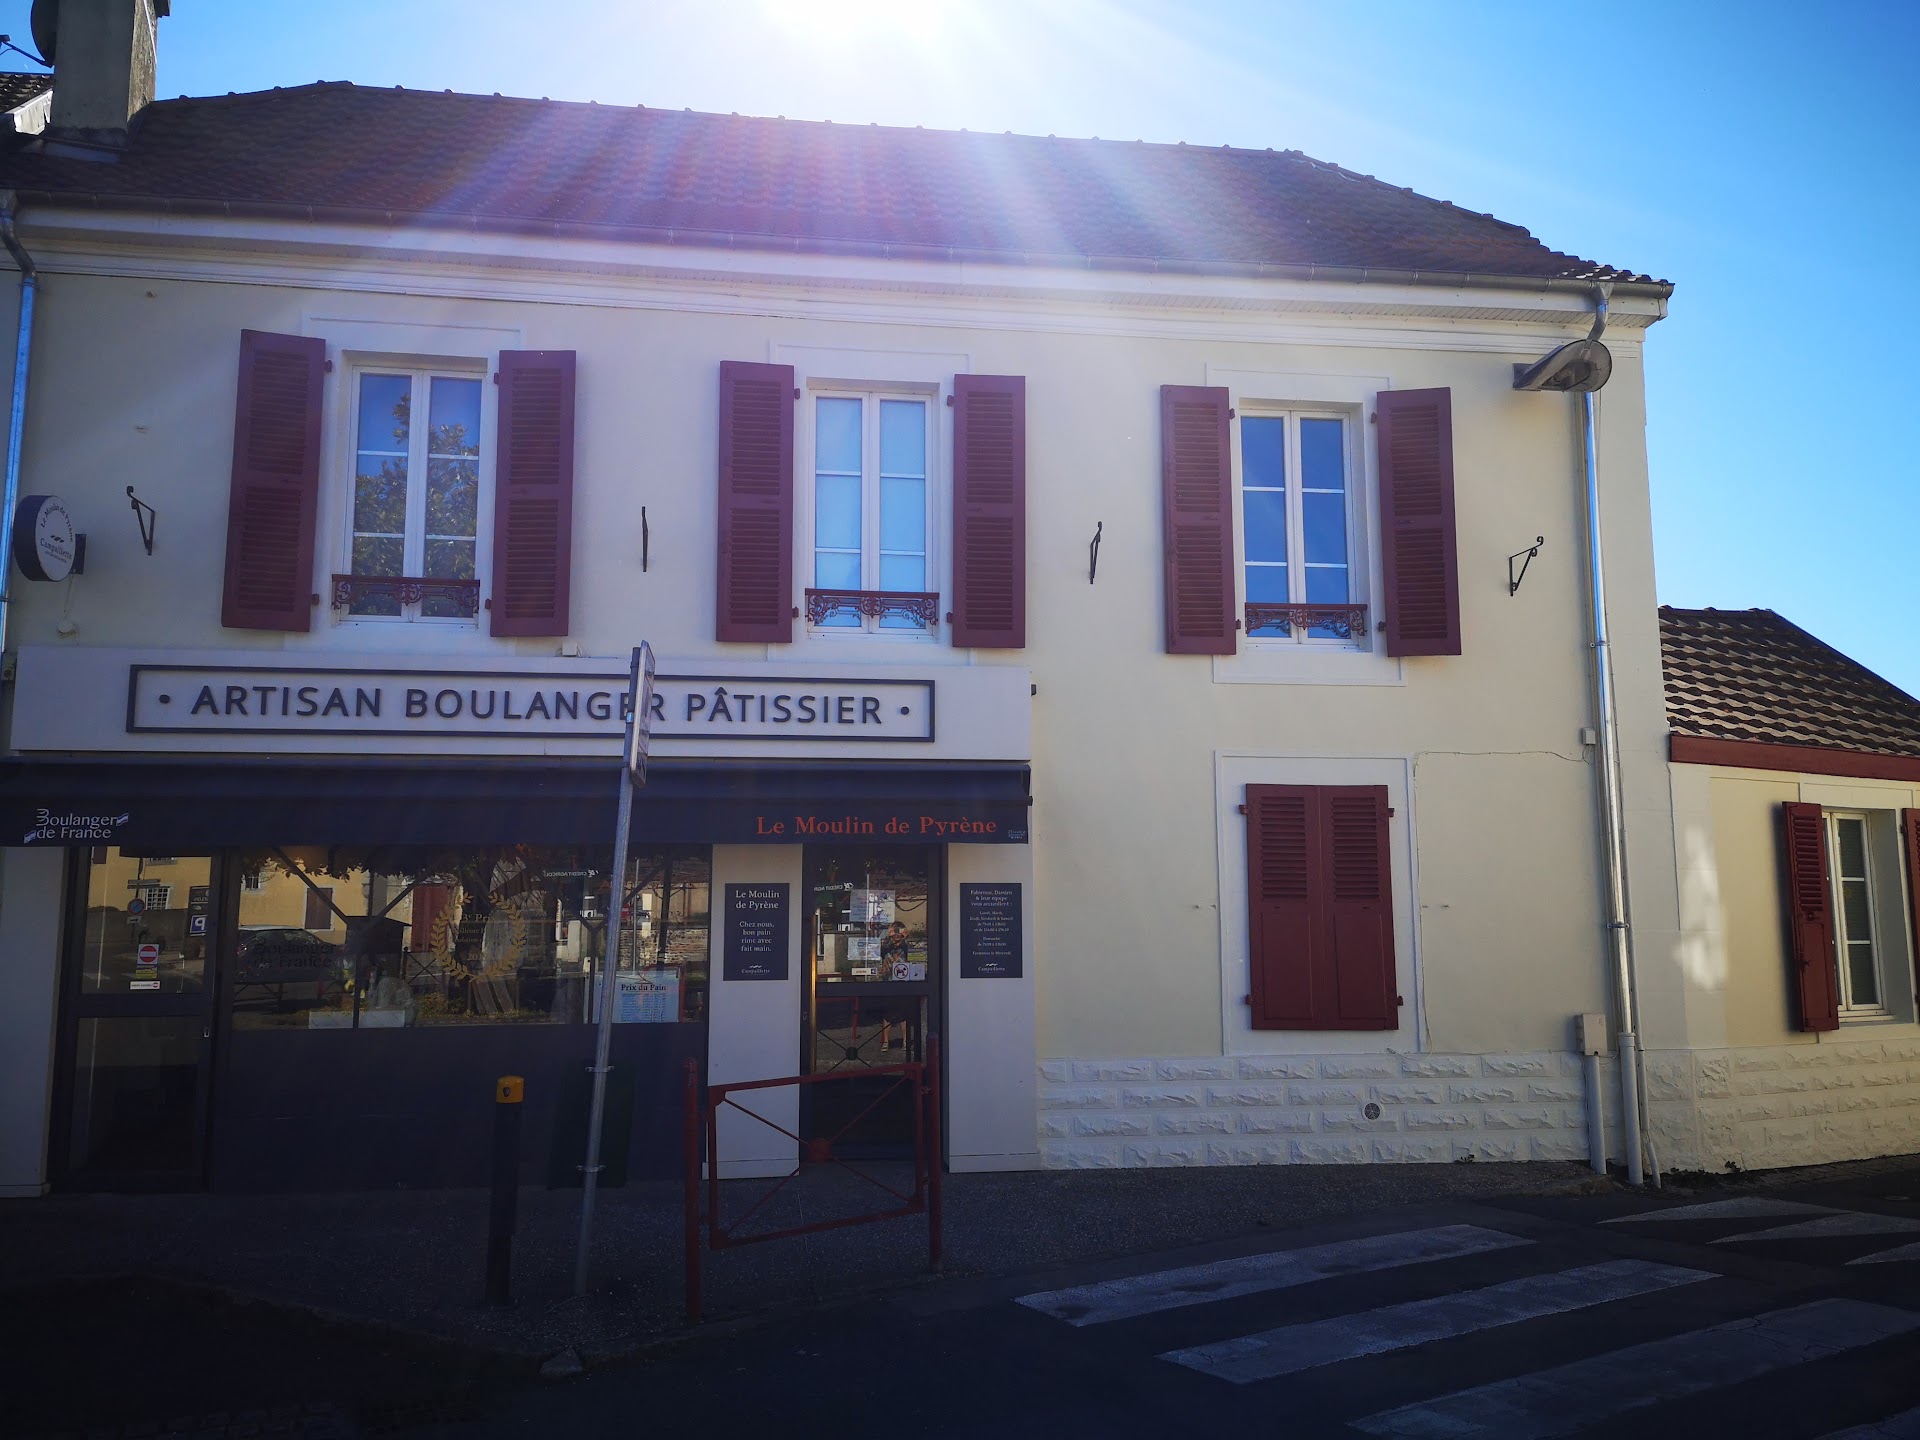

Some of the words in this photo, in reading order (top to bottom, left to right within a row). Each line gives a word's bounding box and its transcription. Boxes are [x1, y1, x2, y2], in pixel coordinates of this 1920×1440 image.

[190, 684, 383, 718] ARTISAN
[686, 686, 882, 724] PÂTISSIER
[36, 808, 117, 829] Boulanger
[757, 816, 785, 834] Le
[794, 815, 875, 834] Moulin
[884, 816, 911, 834] de
[919, 816, 998, 837] Pyrène
[36, 826, 56, 839] de
[60, 827, 112, 839] France
[735, 889, 747, 898] Le
[748, 889, 780, 898] Moulin
[735, 900, 747, 909] de
[748, 900, 779, 911] Pyrène
[739, 920, 756, 928] Chez
[742, 928, 756, 936] bon
[756, 929, 771, 937] pain
[621, 983, 637, 991] Prix
[638, 983, 648, 991] du
[650, 983, 667, 991] Pain
